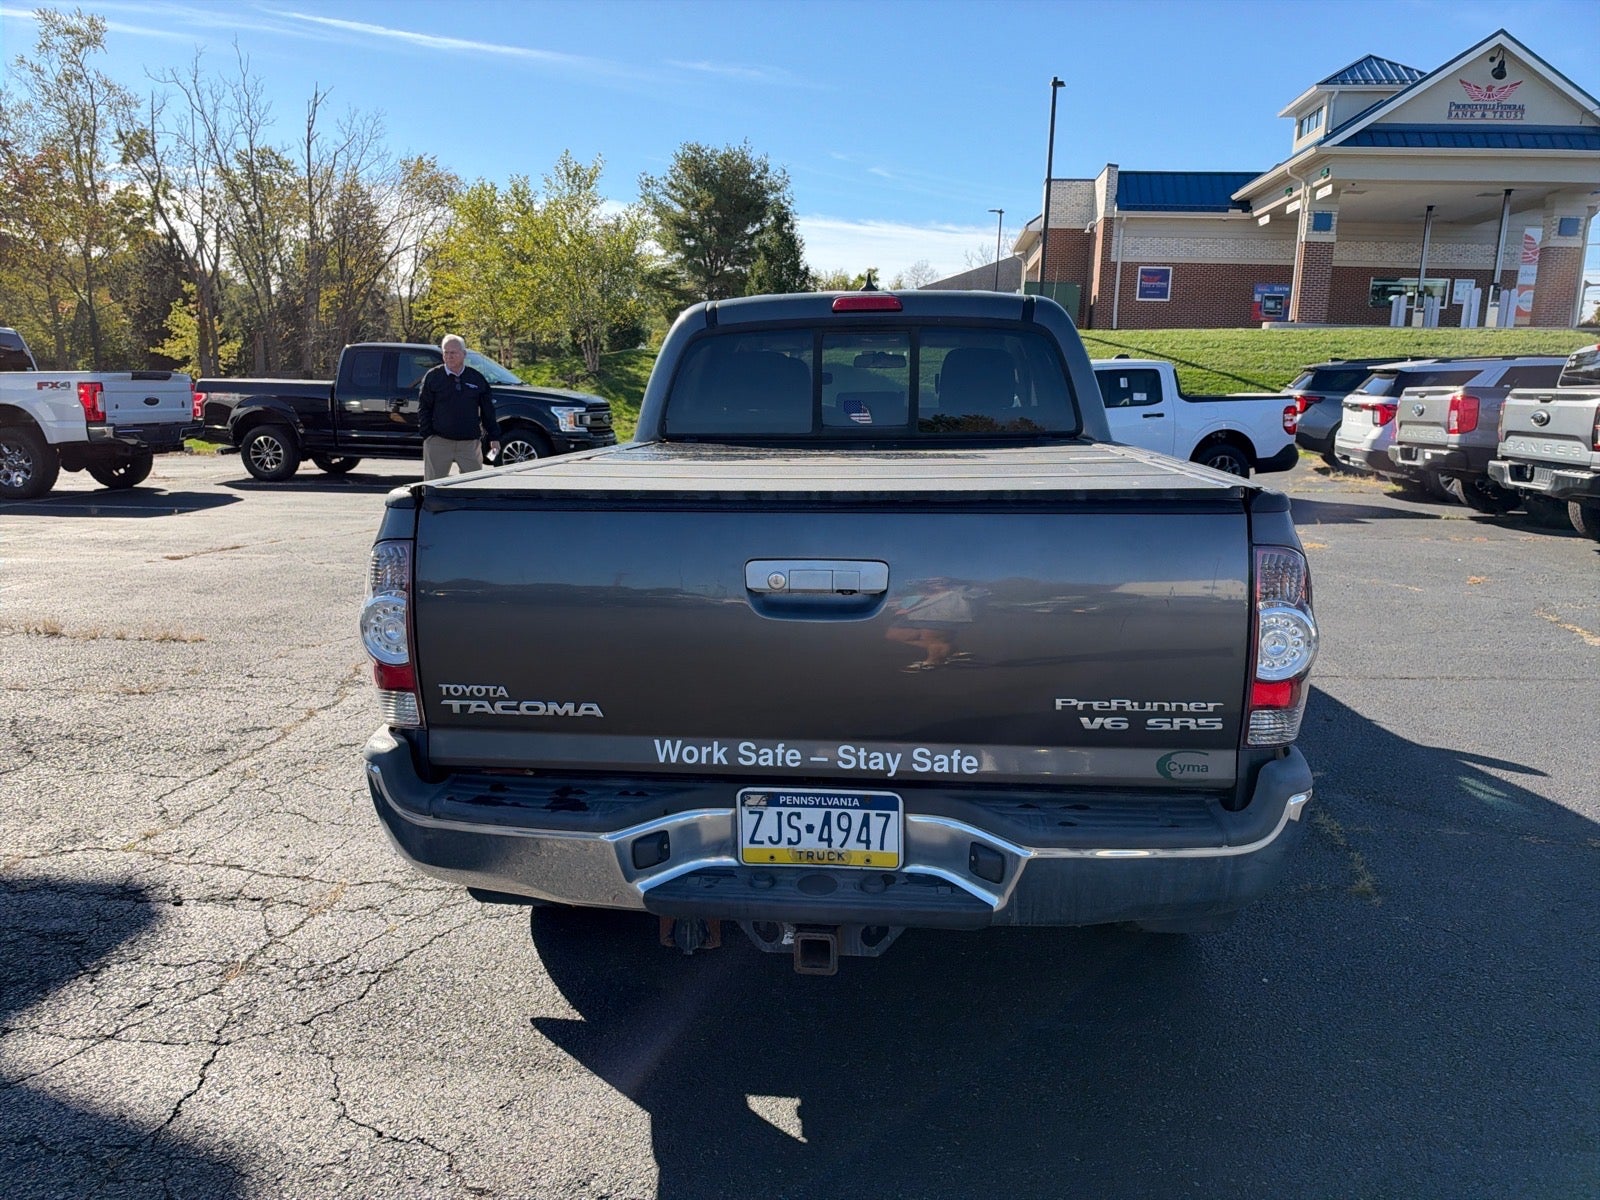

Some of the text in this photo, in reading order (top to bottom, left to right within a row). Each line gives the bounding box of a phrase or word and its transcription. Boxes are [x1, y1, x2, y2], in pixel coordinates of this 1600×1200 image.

[1493, 111, 1525, 119] TRUST
[37, 381, 71, 390] FX4
[1504, 440, 1582, 457] RANGER
[438, 684, 509, 698] TOYOTA
[441, 700, 604, 717] TACOMA
[1055, 698, 1224, 713] PreRunner
[1079, 717, 1223, 731] V6 SR5
[654, 739, 728, 764] Work
[737, 742, 801, 767] Safe
[837, 744, 902, 777] Stay
[912, 748, 978, 774] Safe
[1167, 761, 1209, 774] Cyma
[780, 796, 860, 807] PENNSYLVANIA
[797, 850, 845, 861] TRUCK
